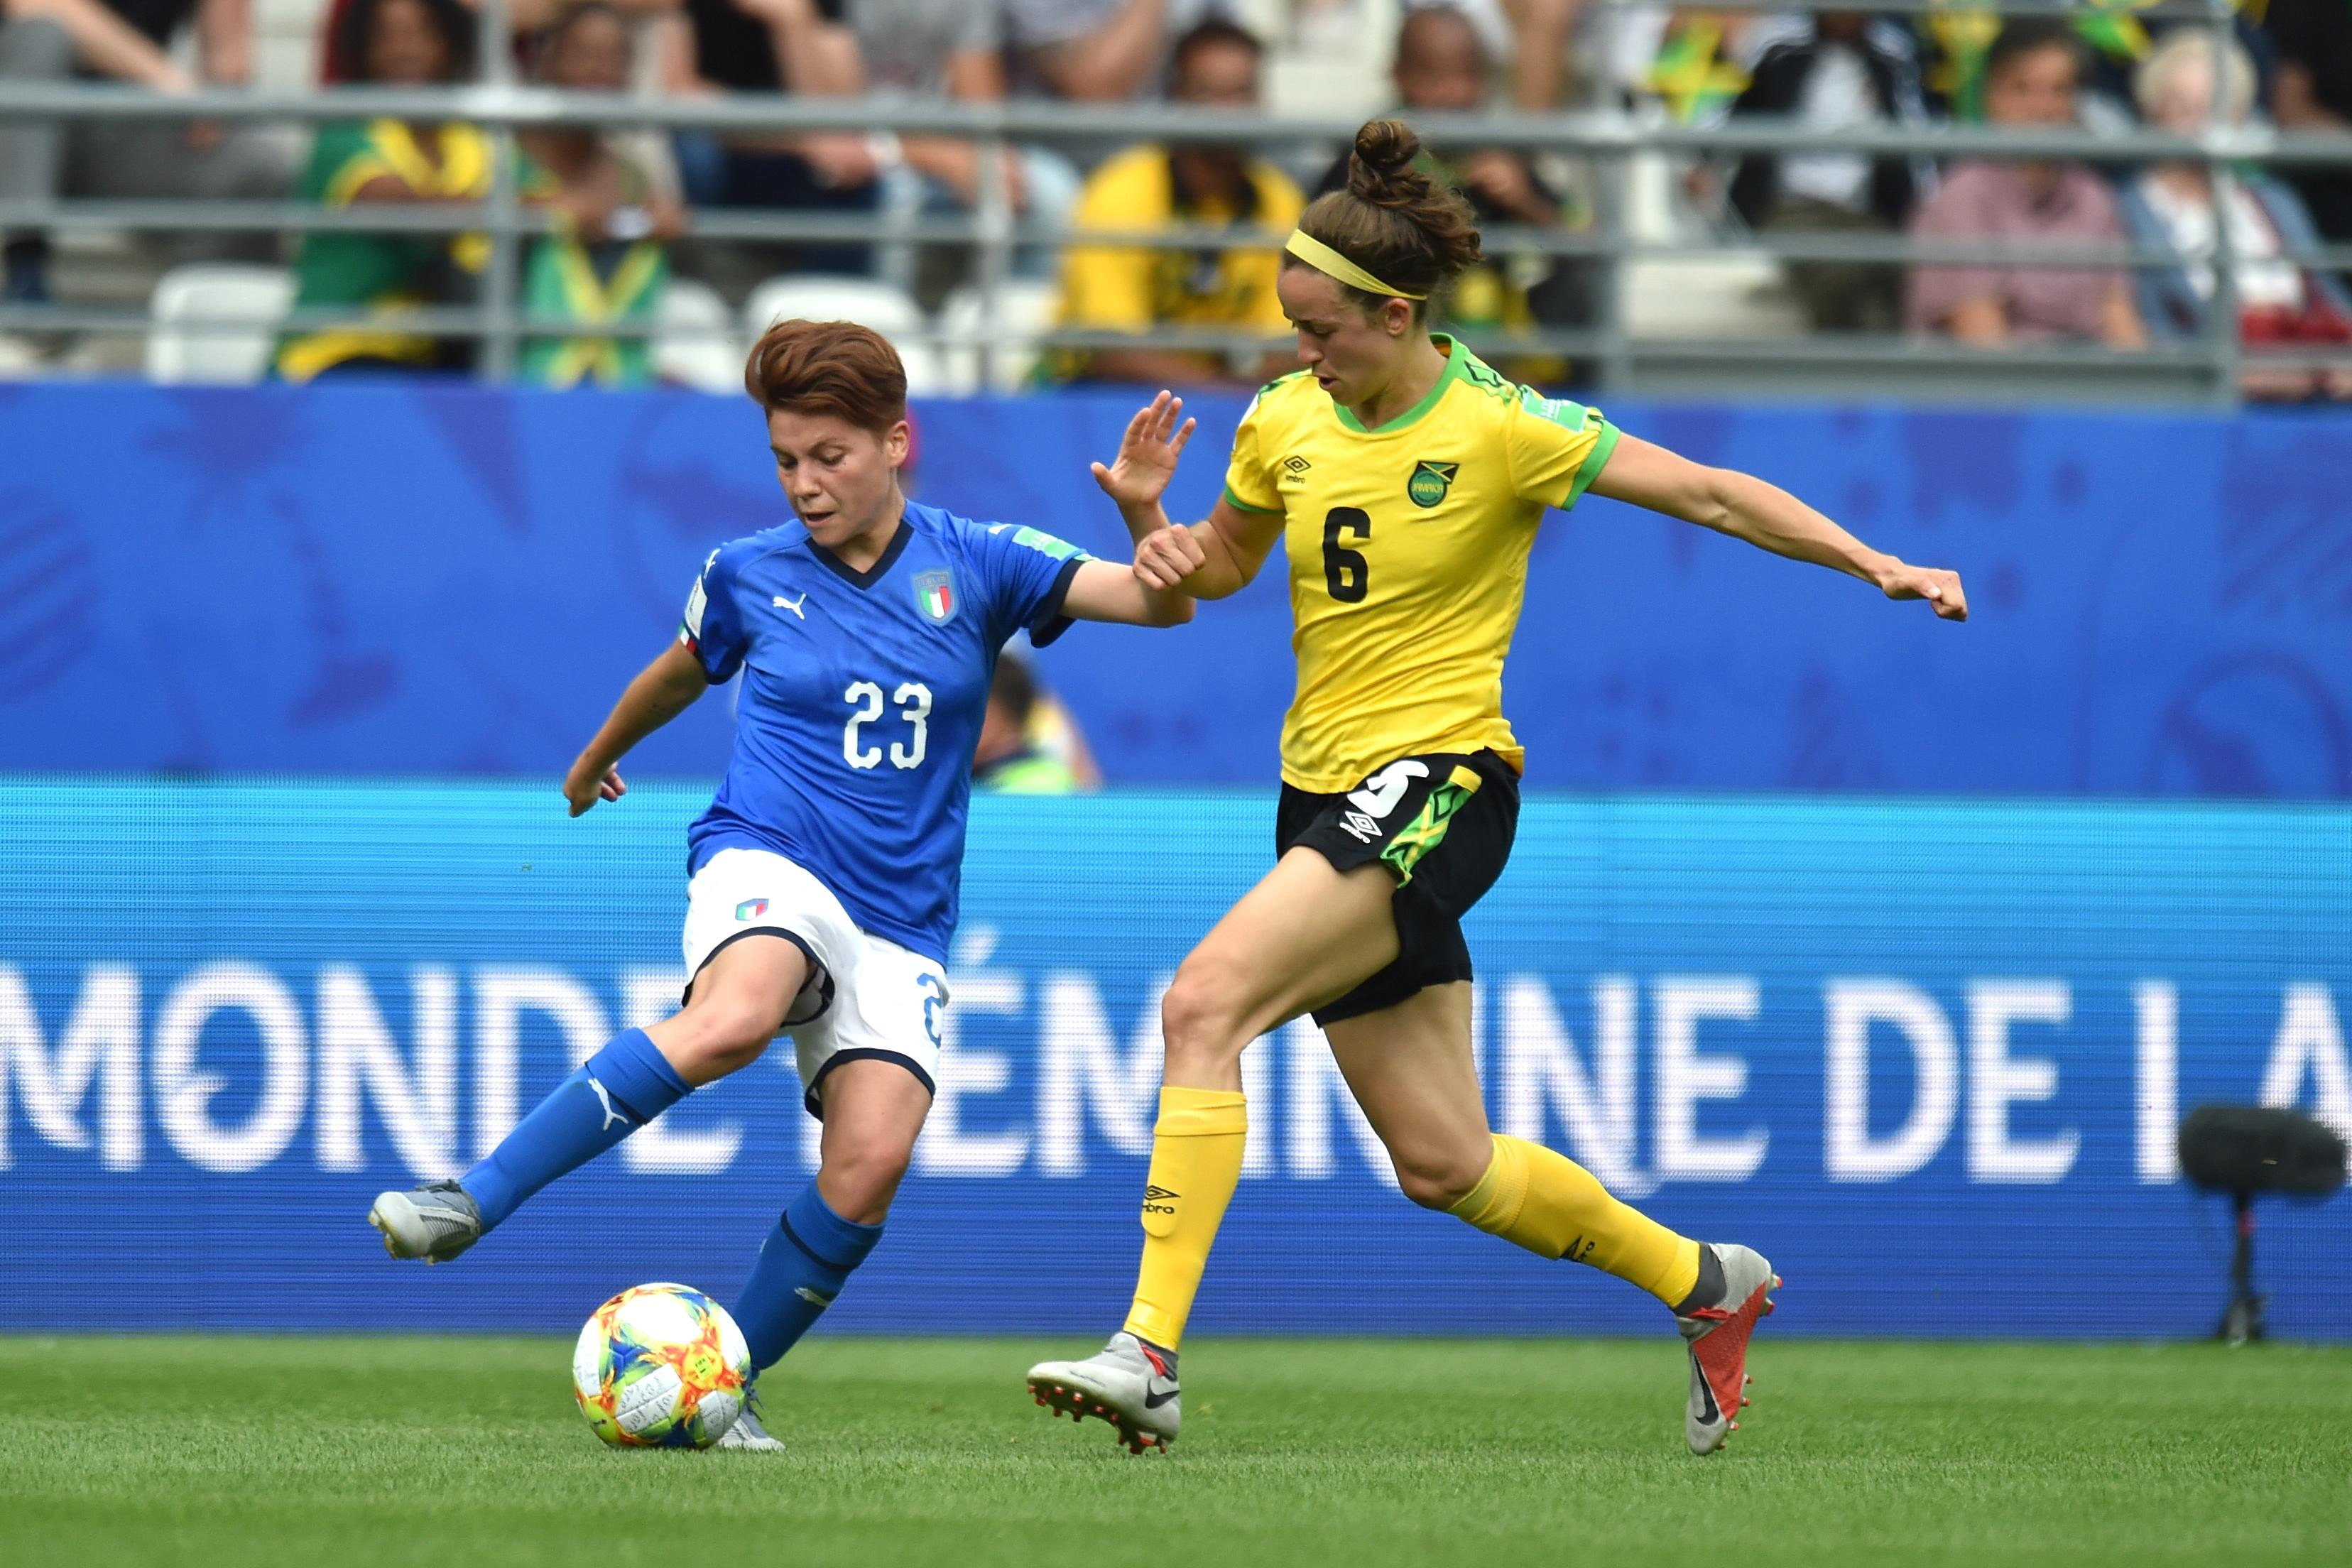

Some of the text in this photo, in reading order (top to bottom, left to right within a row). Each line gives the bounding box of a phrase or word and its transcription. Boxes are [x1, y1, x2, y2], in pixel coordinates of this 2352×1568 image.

[1322, 506, 1371, 604] 6
[844, 682, 932, 770] 23
[1822, 973, 2082, 1185] DE
[1141, 1202, 1175, 1215] bro
